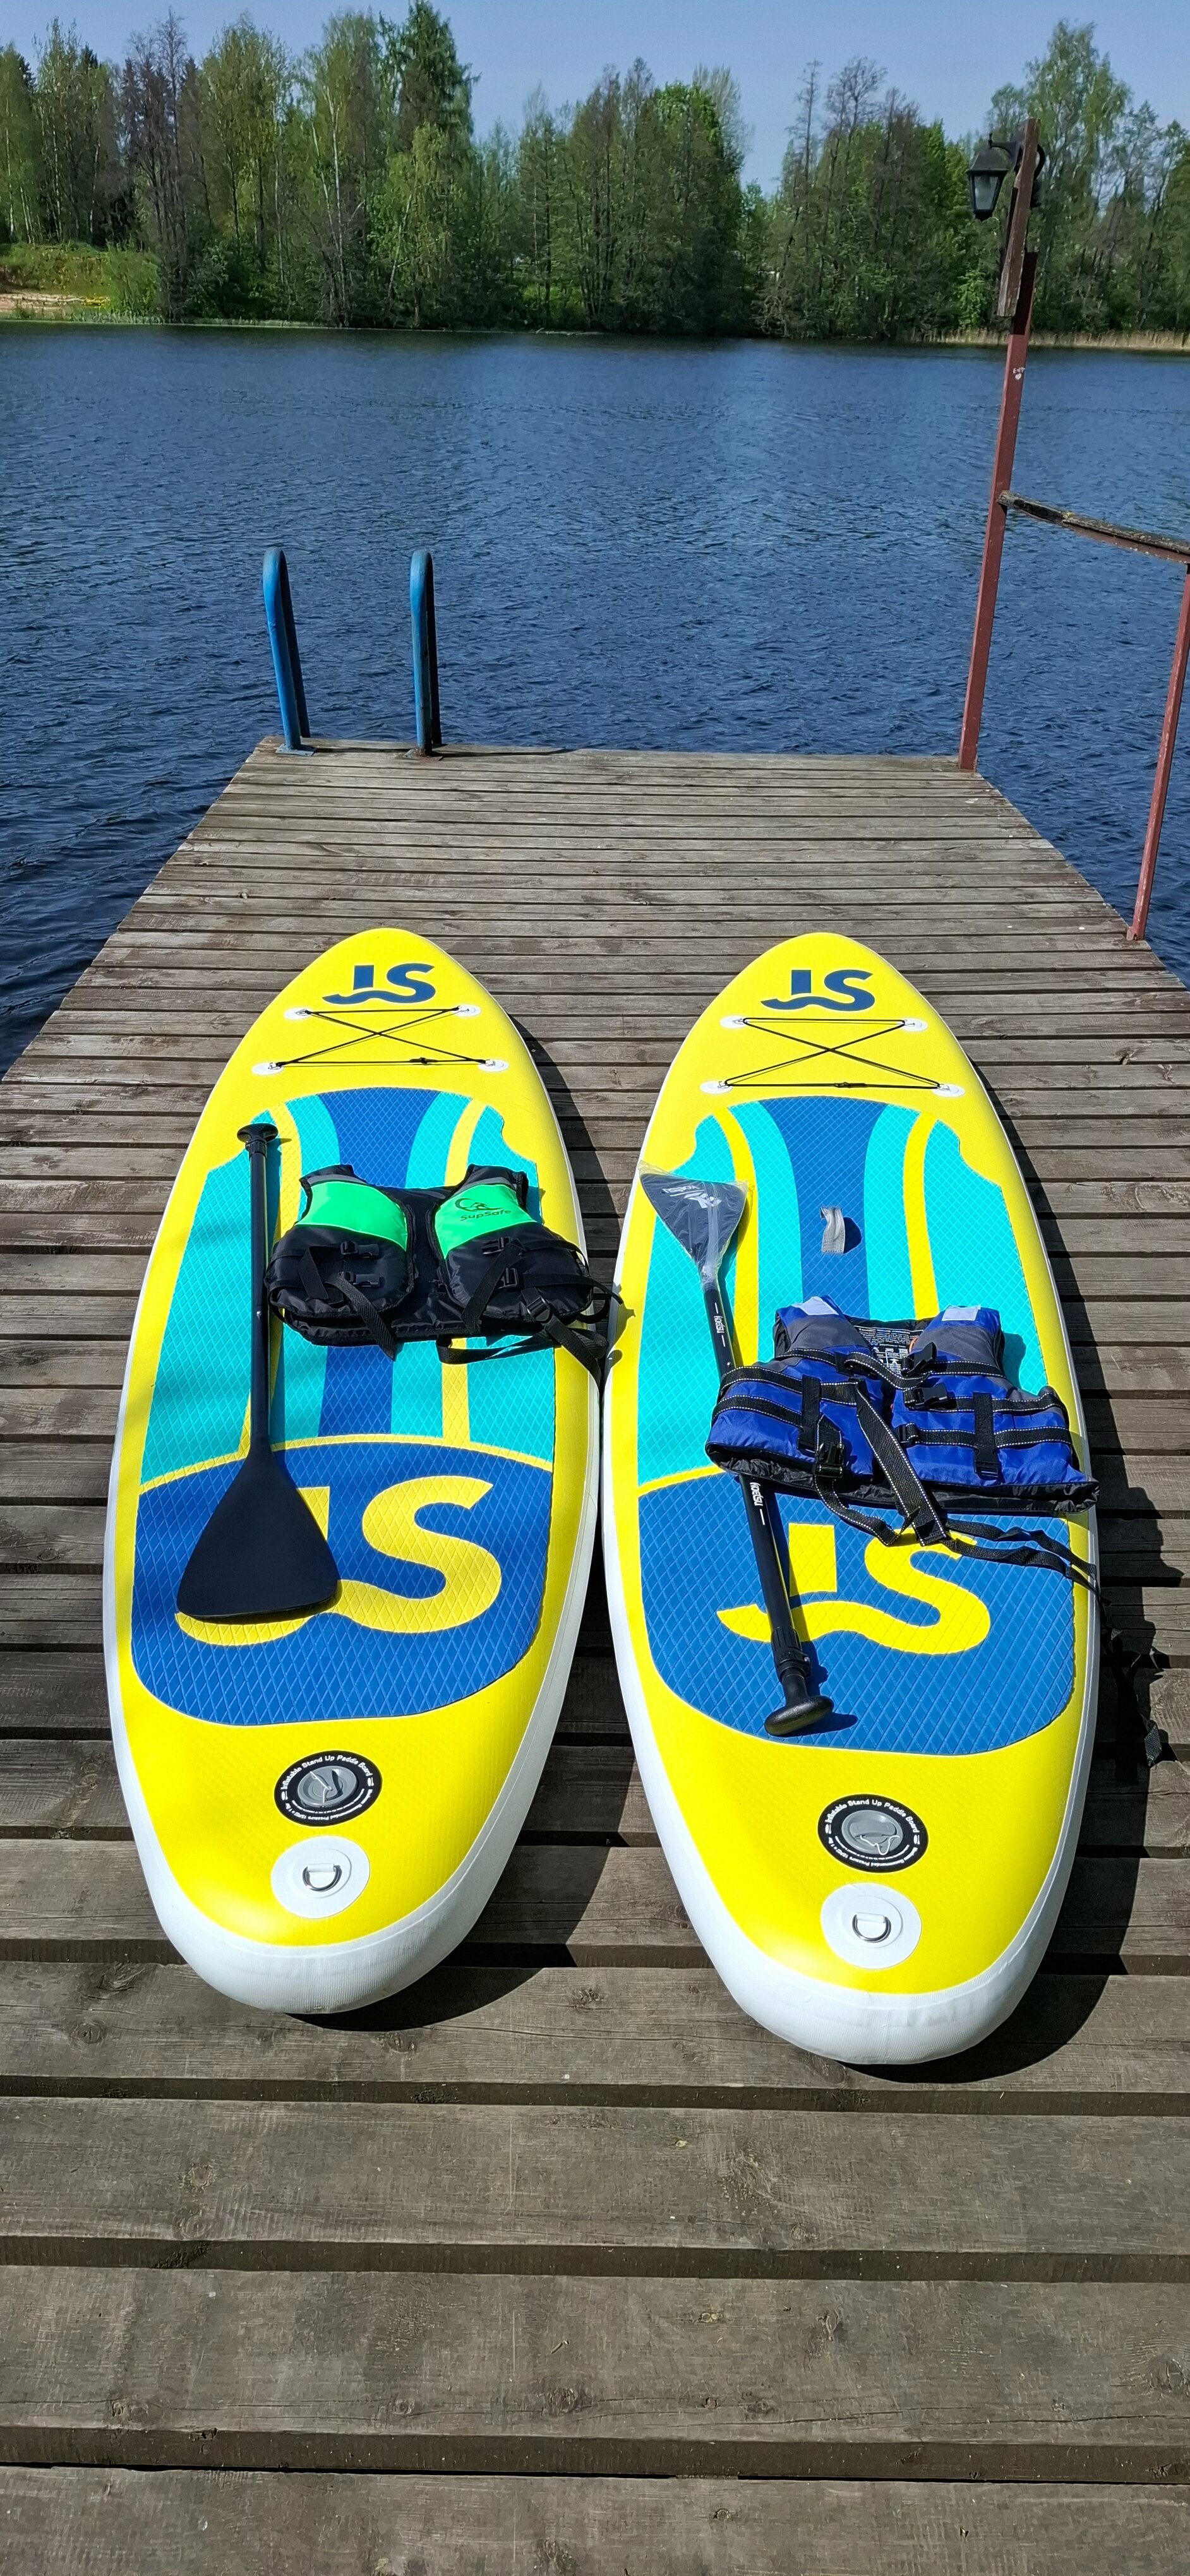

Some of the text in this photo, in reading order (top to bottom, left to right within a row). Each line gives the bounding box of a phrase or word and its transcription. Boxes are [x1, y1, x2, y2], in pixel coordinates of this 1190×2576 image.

[460, 1209, 512, 1221] SupSafe
[280, 1767, 302, 1789] Inflatable
[302, 1757, 323, 1768] Stand
[337, 1755, 359, 1765] Paddle
[358, 1762, 373, 1776] Board
[884, 1803, 906, 1818] Paddle
[906, 1816, 920, 1833] Board
